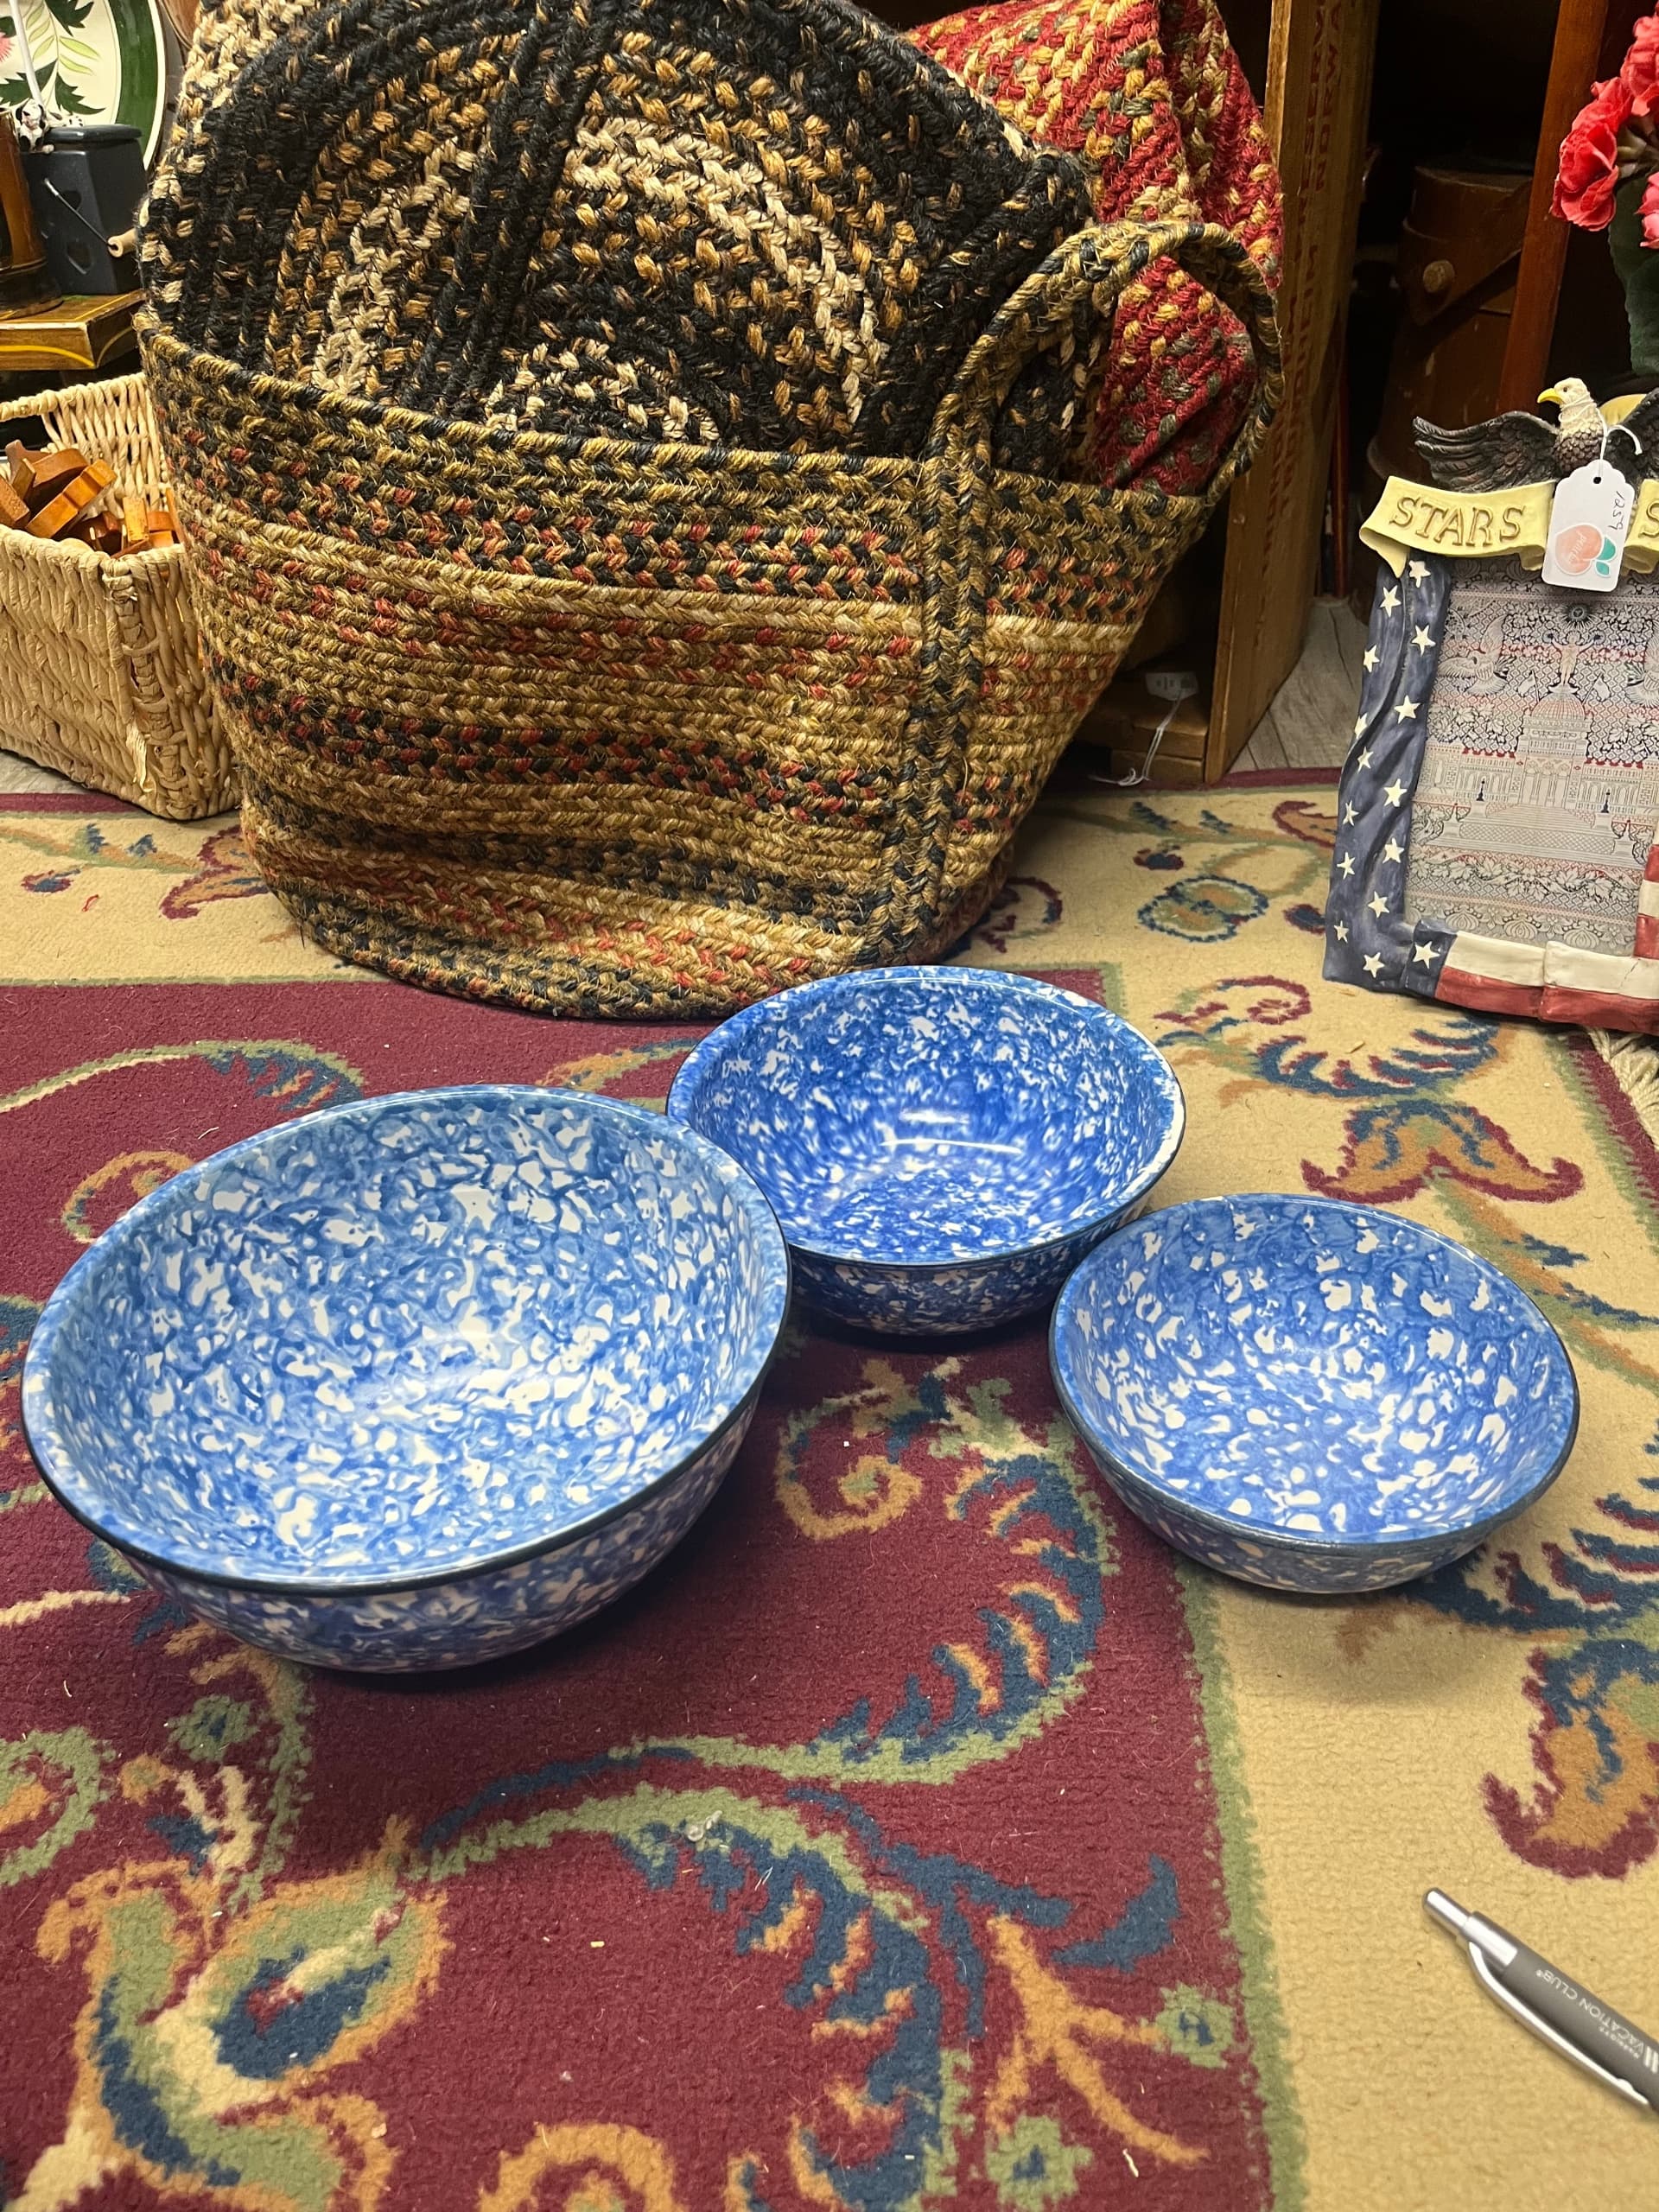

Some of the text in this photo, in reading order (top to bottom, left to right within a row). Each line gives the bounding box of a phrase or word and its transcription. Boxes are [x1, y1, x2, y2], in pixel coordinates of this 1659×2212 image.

[1315, 1, 1341, 191] NORWA
[1389, 496, 1659, 547] STARS S
[1579, 1998, 1643, 2056] VACATION
